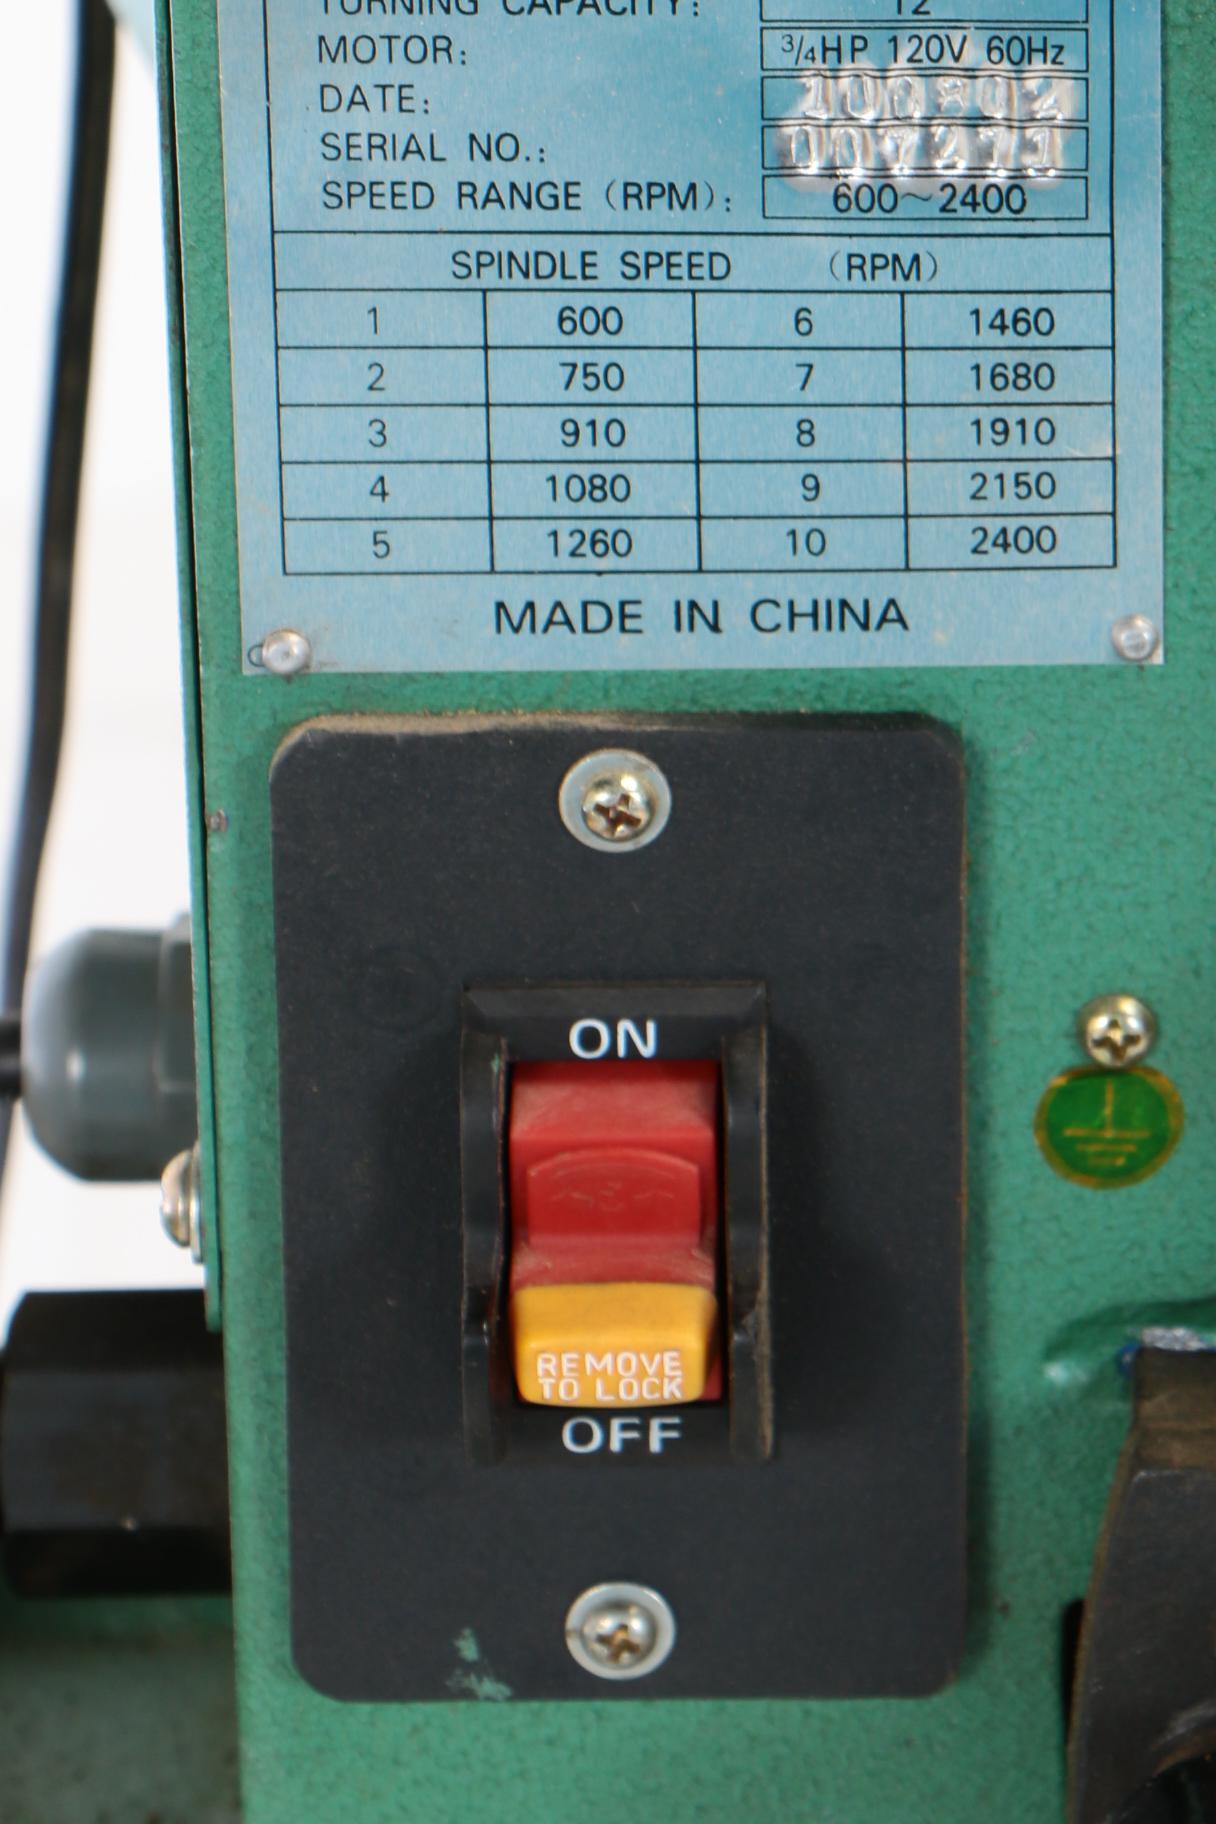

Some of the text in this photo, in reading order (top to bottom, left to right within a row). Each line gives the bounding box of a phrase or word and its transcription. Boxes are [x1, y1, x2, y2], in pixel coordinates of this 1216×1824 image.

[318, 34, 466, 66] MOTOR:
[887, 33, 967, 64] 120V
[986, 35, 1065, 66] 60Hz
[319, 83, 429, 115] DATE:
[320, 132, 447, 162] SERIAL
[468, 132, 545, 163] NO.:
[322, 180, 435, 210] SPEED
[457, 180, 582, 211] RANGE
[451, 250, 938, 282] SPINDLE SPEED (RPM)
[367, 305, 1055, 337] 1 600 6 1460
[367, 361, 1056, 392] 2 750 7 1680
[368, 417, 1056, 448] 3 910 8 1910
[369, 471, 1057, 503] 4 1080 9 2150
[372, 525, 1057, 559] 5 1260 10 2400
[495, 597, 909, 635] MADE IN CHINA
[569, 1018, 657, 1059] ON
[537, 1351, 683, 1376] REMOVE
[538, 1377, 683, 1400] TO LOCK
[562, 1417, 681, 1454] OFF
